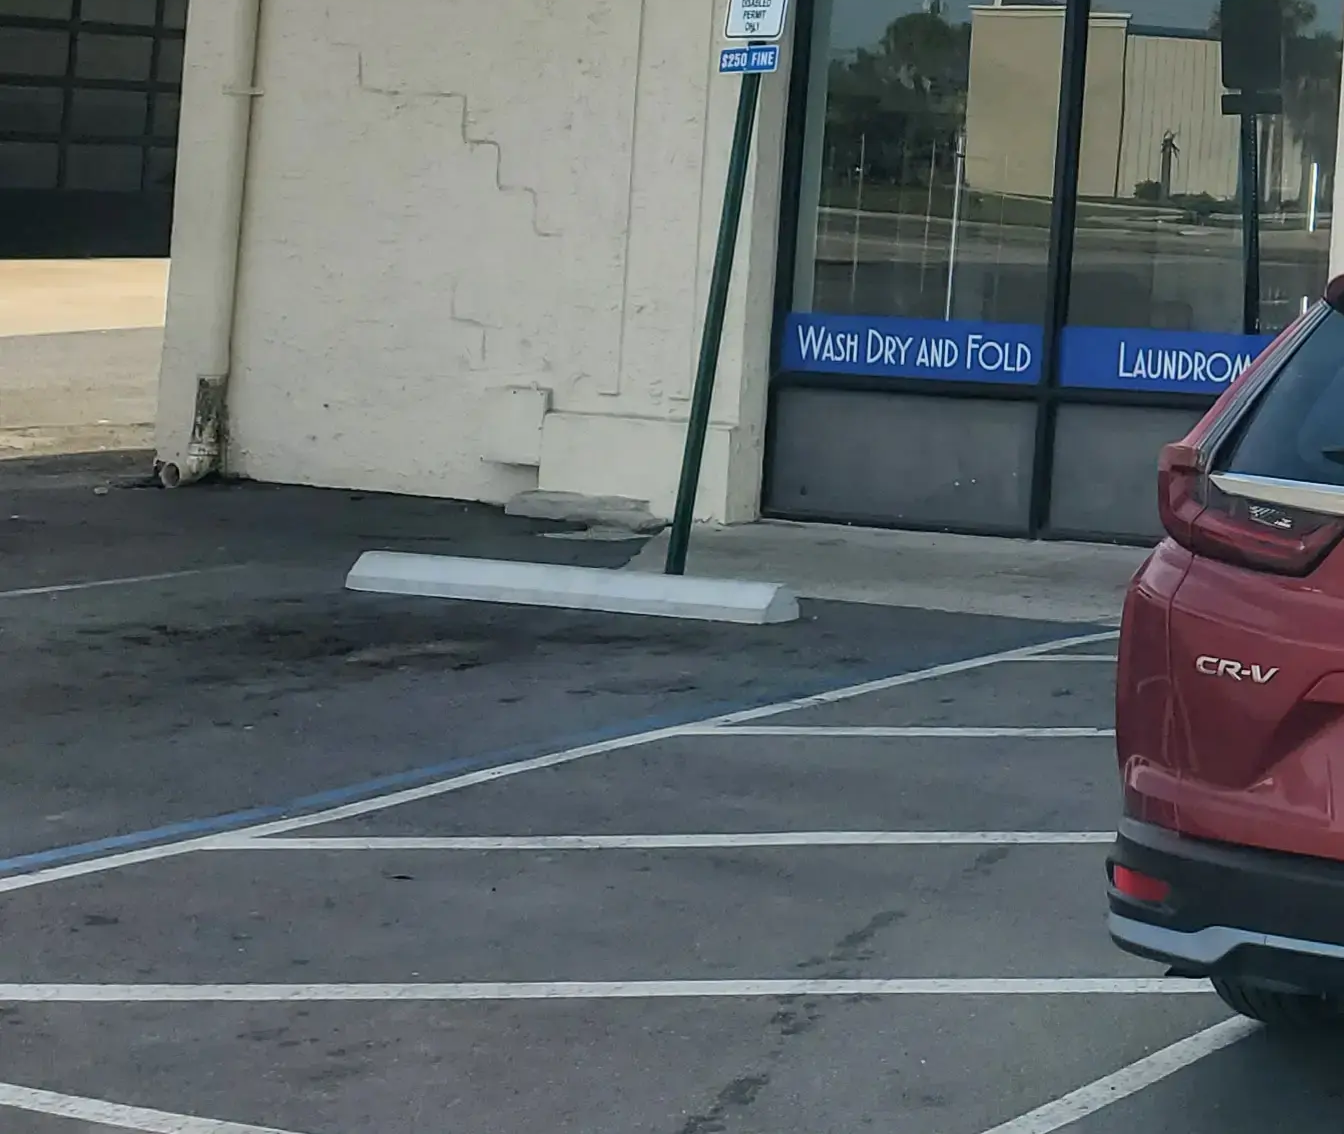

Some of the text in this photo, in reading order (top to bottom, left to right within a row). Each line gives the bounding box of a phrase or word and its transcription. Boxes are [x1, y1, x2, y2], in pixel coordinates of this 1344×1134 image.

[743, 10, 767, 20] PERMIT
[721, 50, 775, 69] $250 FINE
[797, 324, 1032, 373] WASH DRY AND FOLD
[1195, 655, 1280, 684] CR-V
